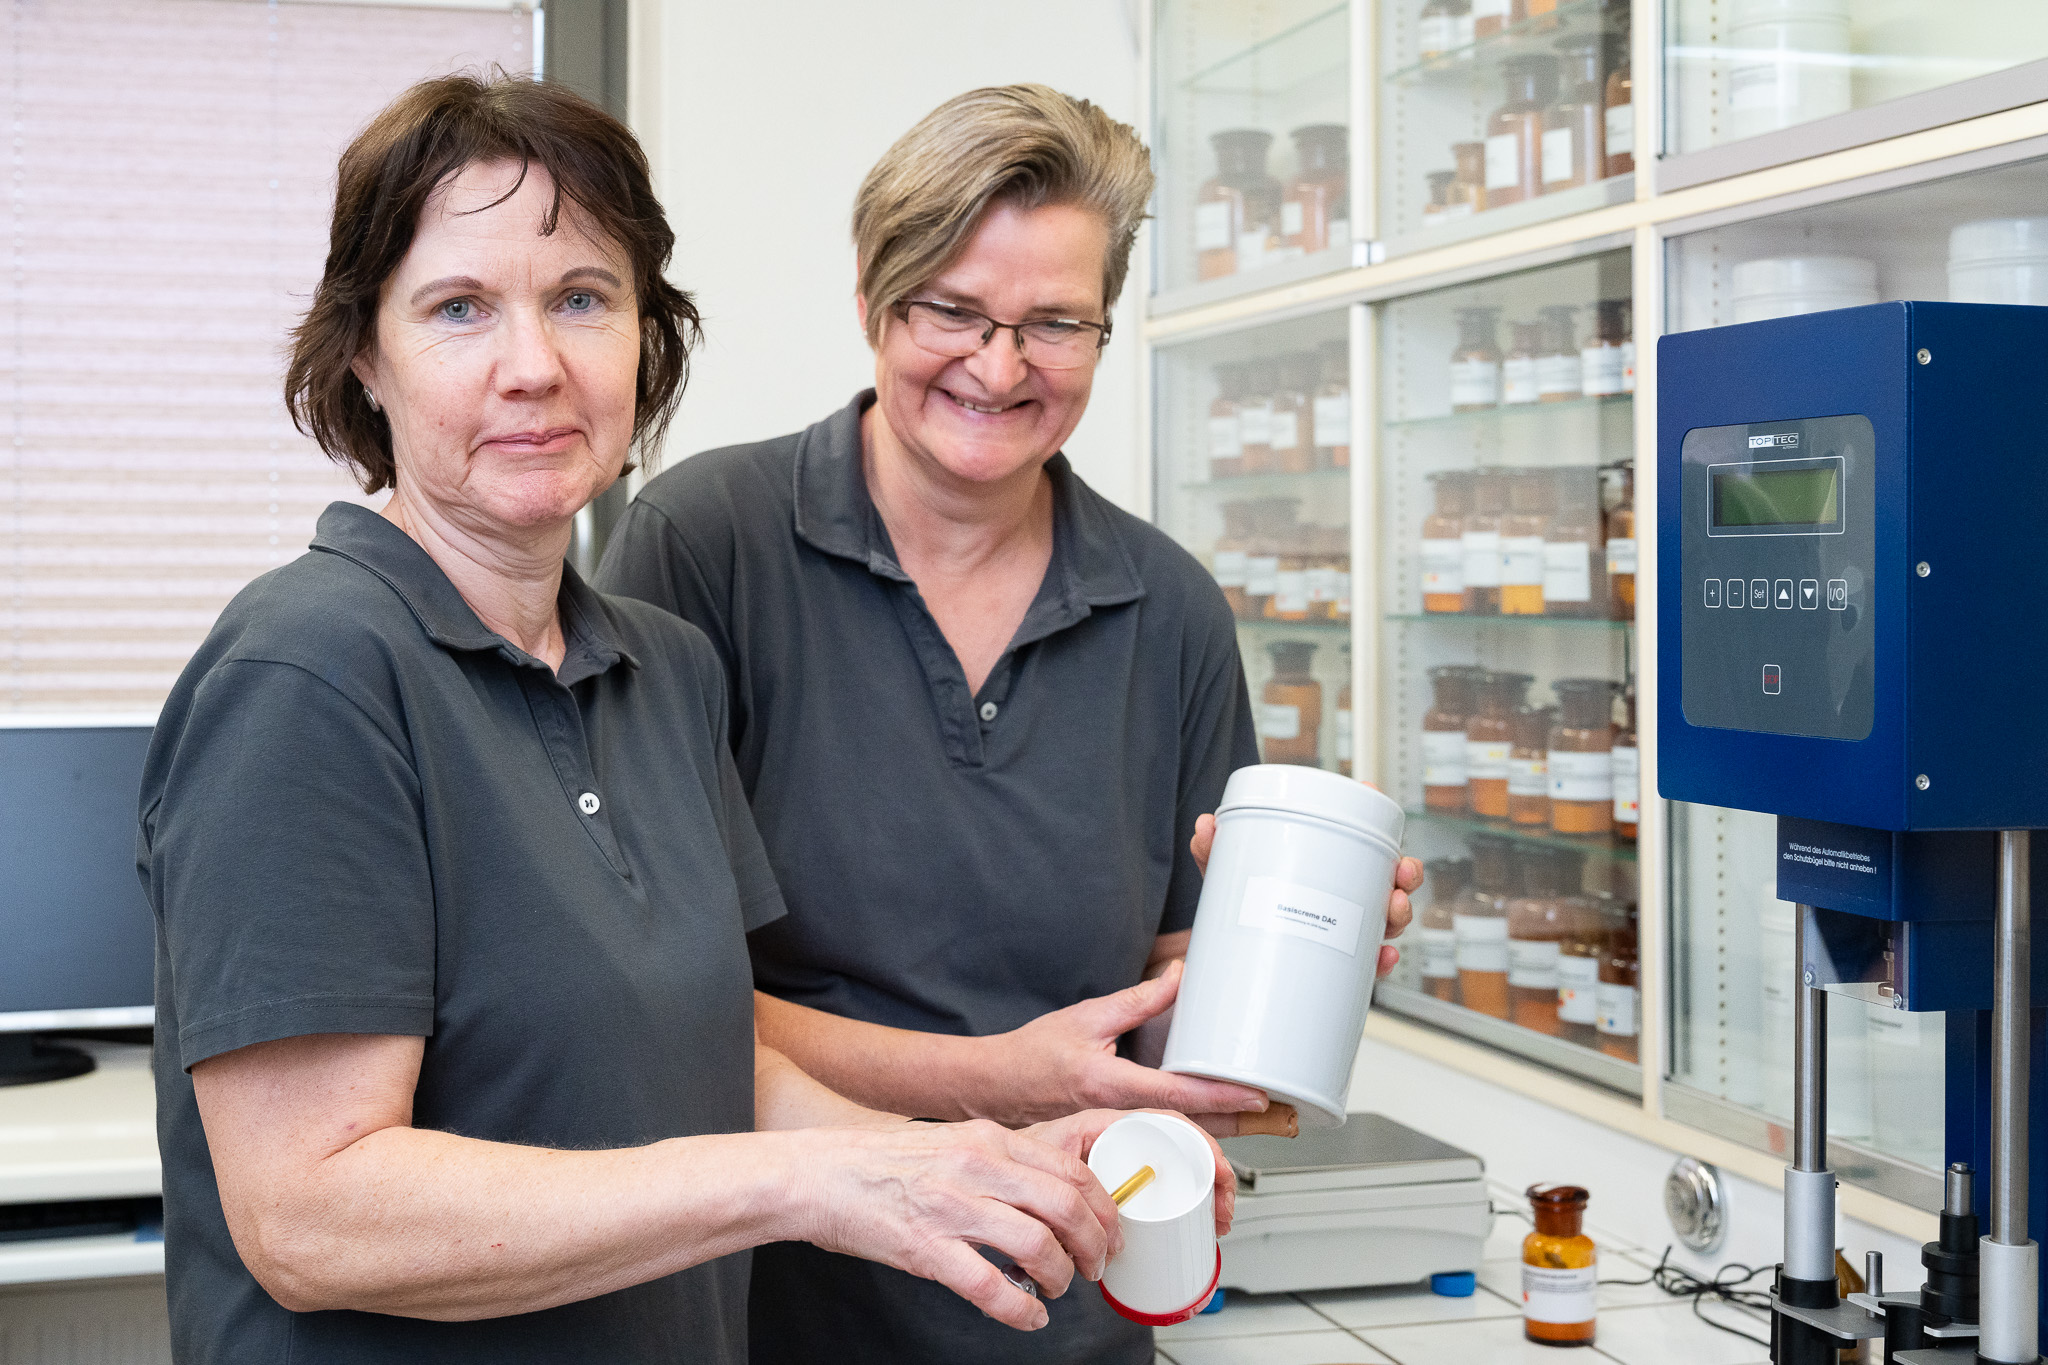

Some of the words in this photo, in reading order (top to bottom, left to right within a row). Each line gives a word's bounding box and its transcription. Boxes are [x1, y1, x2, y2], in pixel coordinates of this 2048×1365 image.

[1754, 588, 1765, 599] Set
[1789, 842, 1811, 853] Während
[1812, 846, 1822, 855] des
[1822, 848, 1870, 862] Automatikbetriebes
[1794, 853, 1823, 866] Schutzbügel
[1824, 858, 1836, 868] bitte
[1836, 860, 1849, 870] nicht
[1849, 864, 1873, 874] anheben
[1277, 903, 1320, 920] Basiscreme
[1321, 915, 1337, 926] DAC
